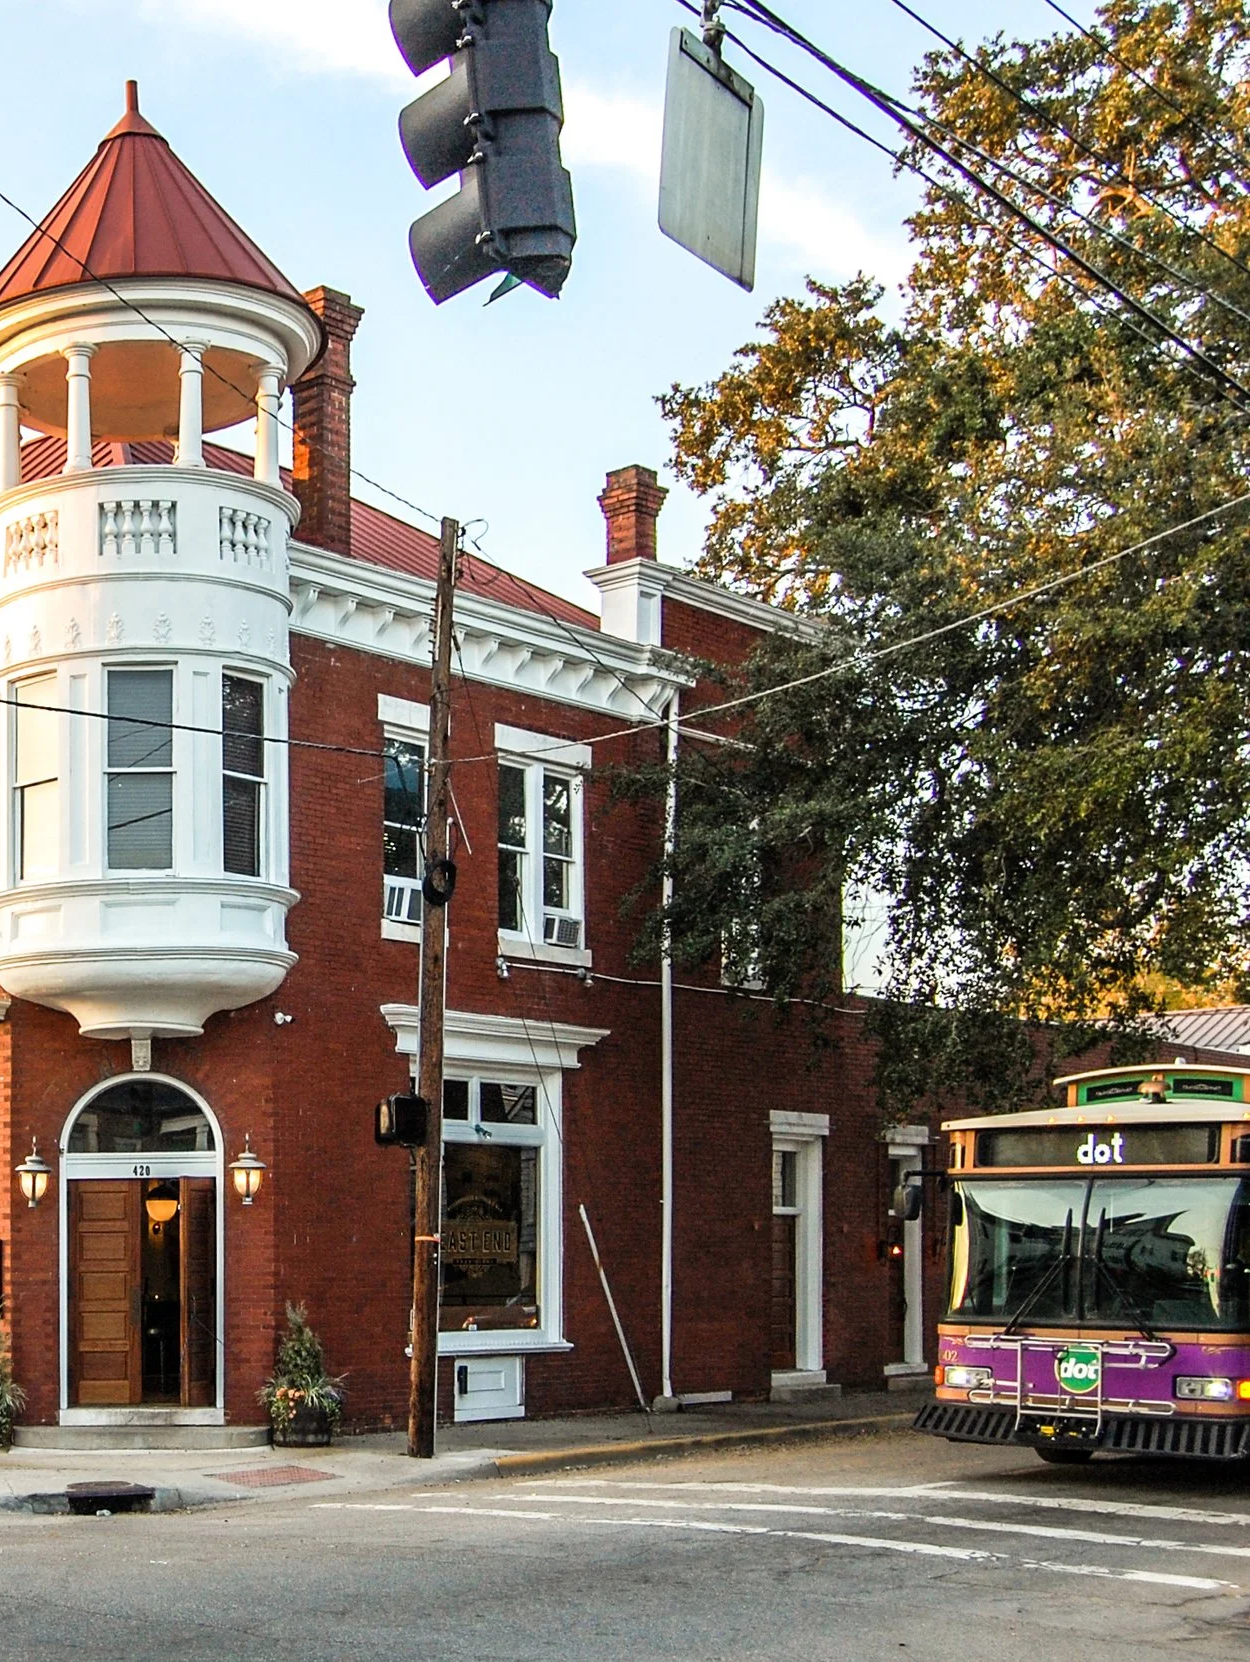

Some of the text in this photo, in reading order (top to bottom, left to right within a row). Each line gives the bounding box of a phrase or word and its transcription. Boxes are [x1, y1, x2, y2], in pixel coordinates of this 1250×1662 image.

[1076, 1132, 1124, 1164] dot
[133, 1165, 150, 1176] 420
[440, 1231, 510, 1252] EAST END
[1060, 1357, 1099, 1379] dot
